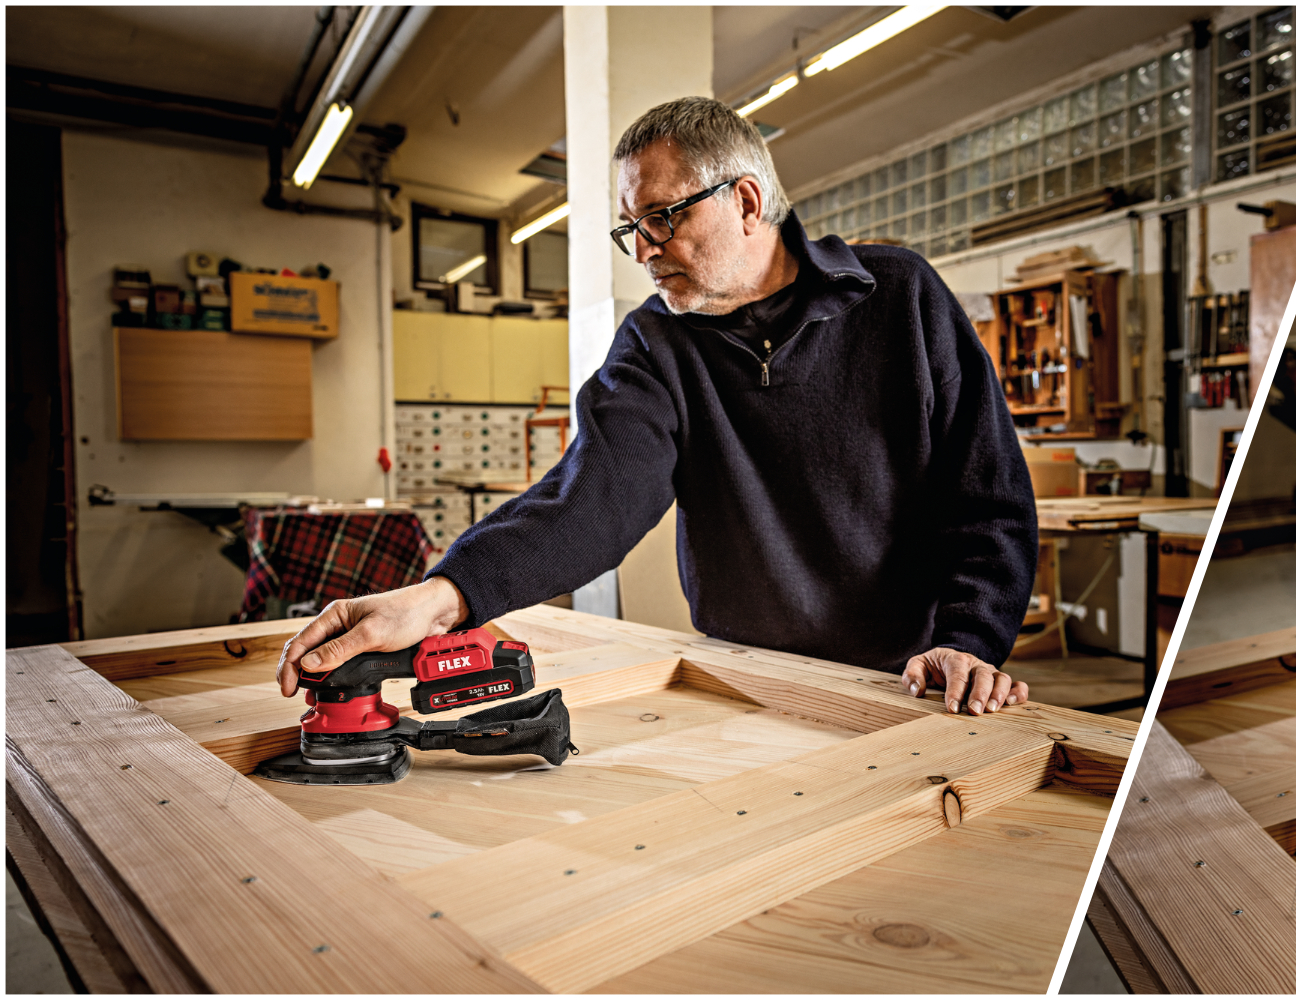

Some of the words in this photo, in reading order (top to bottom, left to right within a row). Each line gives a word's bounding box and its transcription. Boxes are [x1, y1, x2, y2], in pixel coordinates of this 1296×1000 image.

[437, 656, 472, 672] FLEX
[488, 683, 510, 694] FLEX
[338, 692, 345, 701] 2
